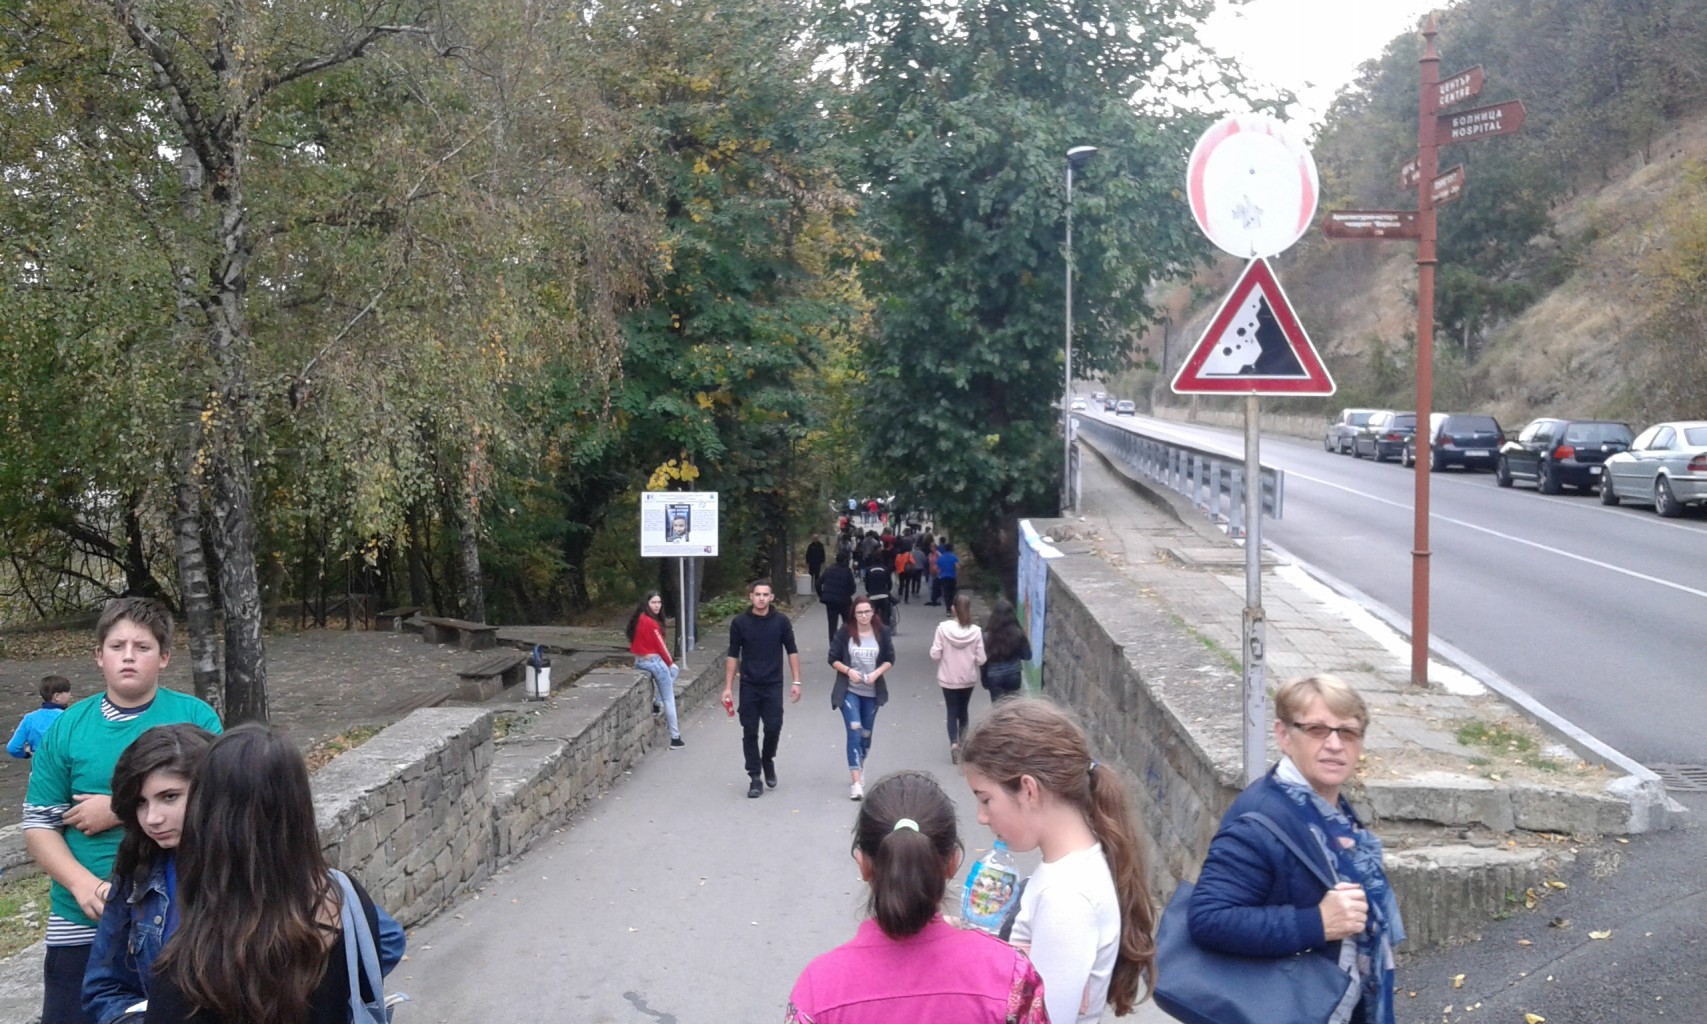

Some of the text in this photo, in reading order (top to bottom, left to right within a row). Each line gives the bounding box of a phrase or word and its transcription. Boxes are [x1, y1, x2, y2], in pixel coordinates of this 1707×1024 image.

[1440, 86, 1470, 105] CENTRE
[1452, 109, 1502, 127] БОЛНИЦА
[1452, 121, 1502, 138] HOSPITAL
